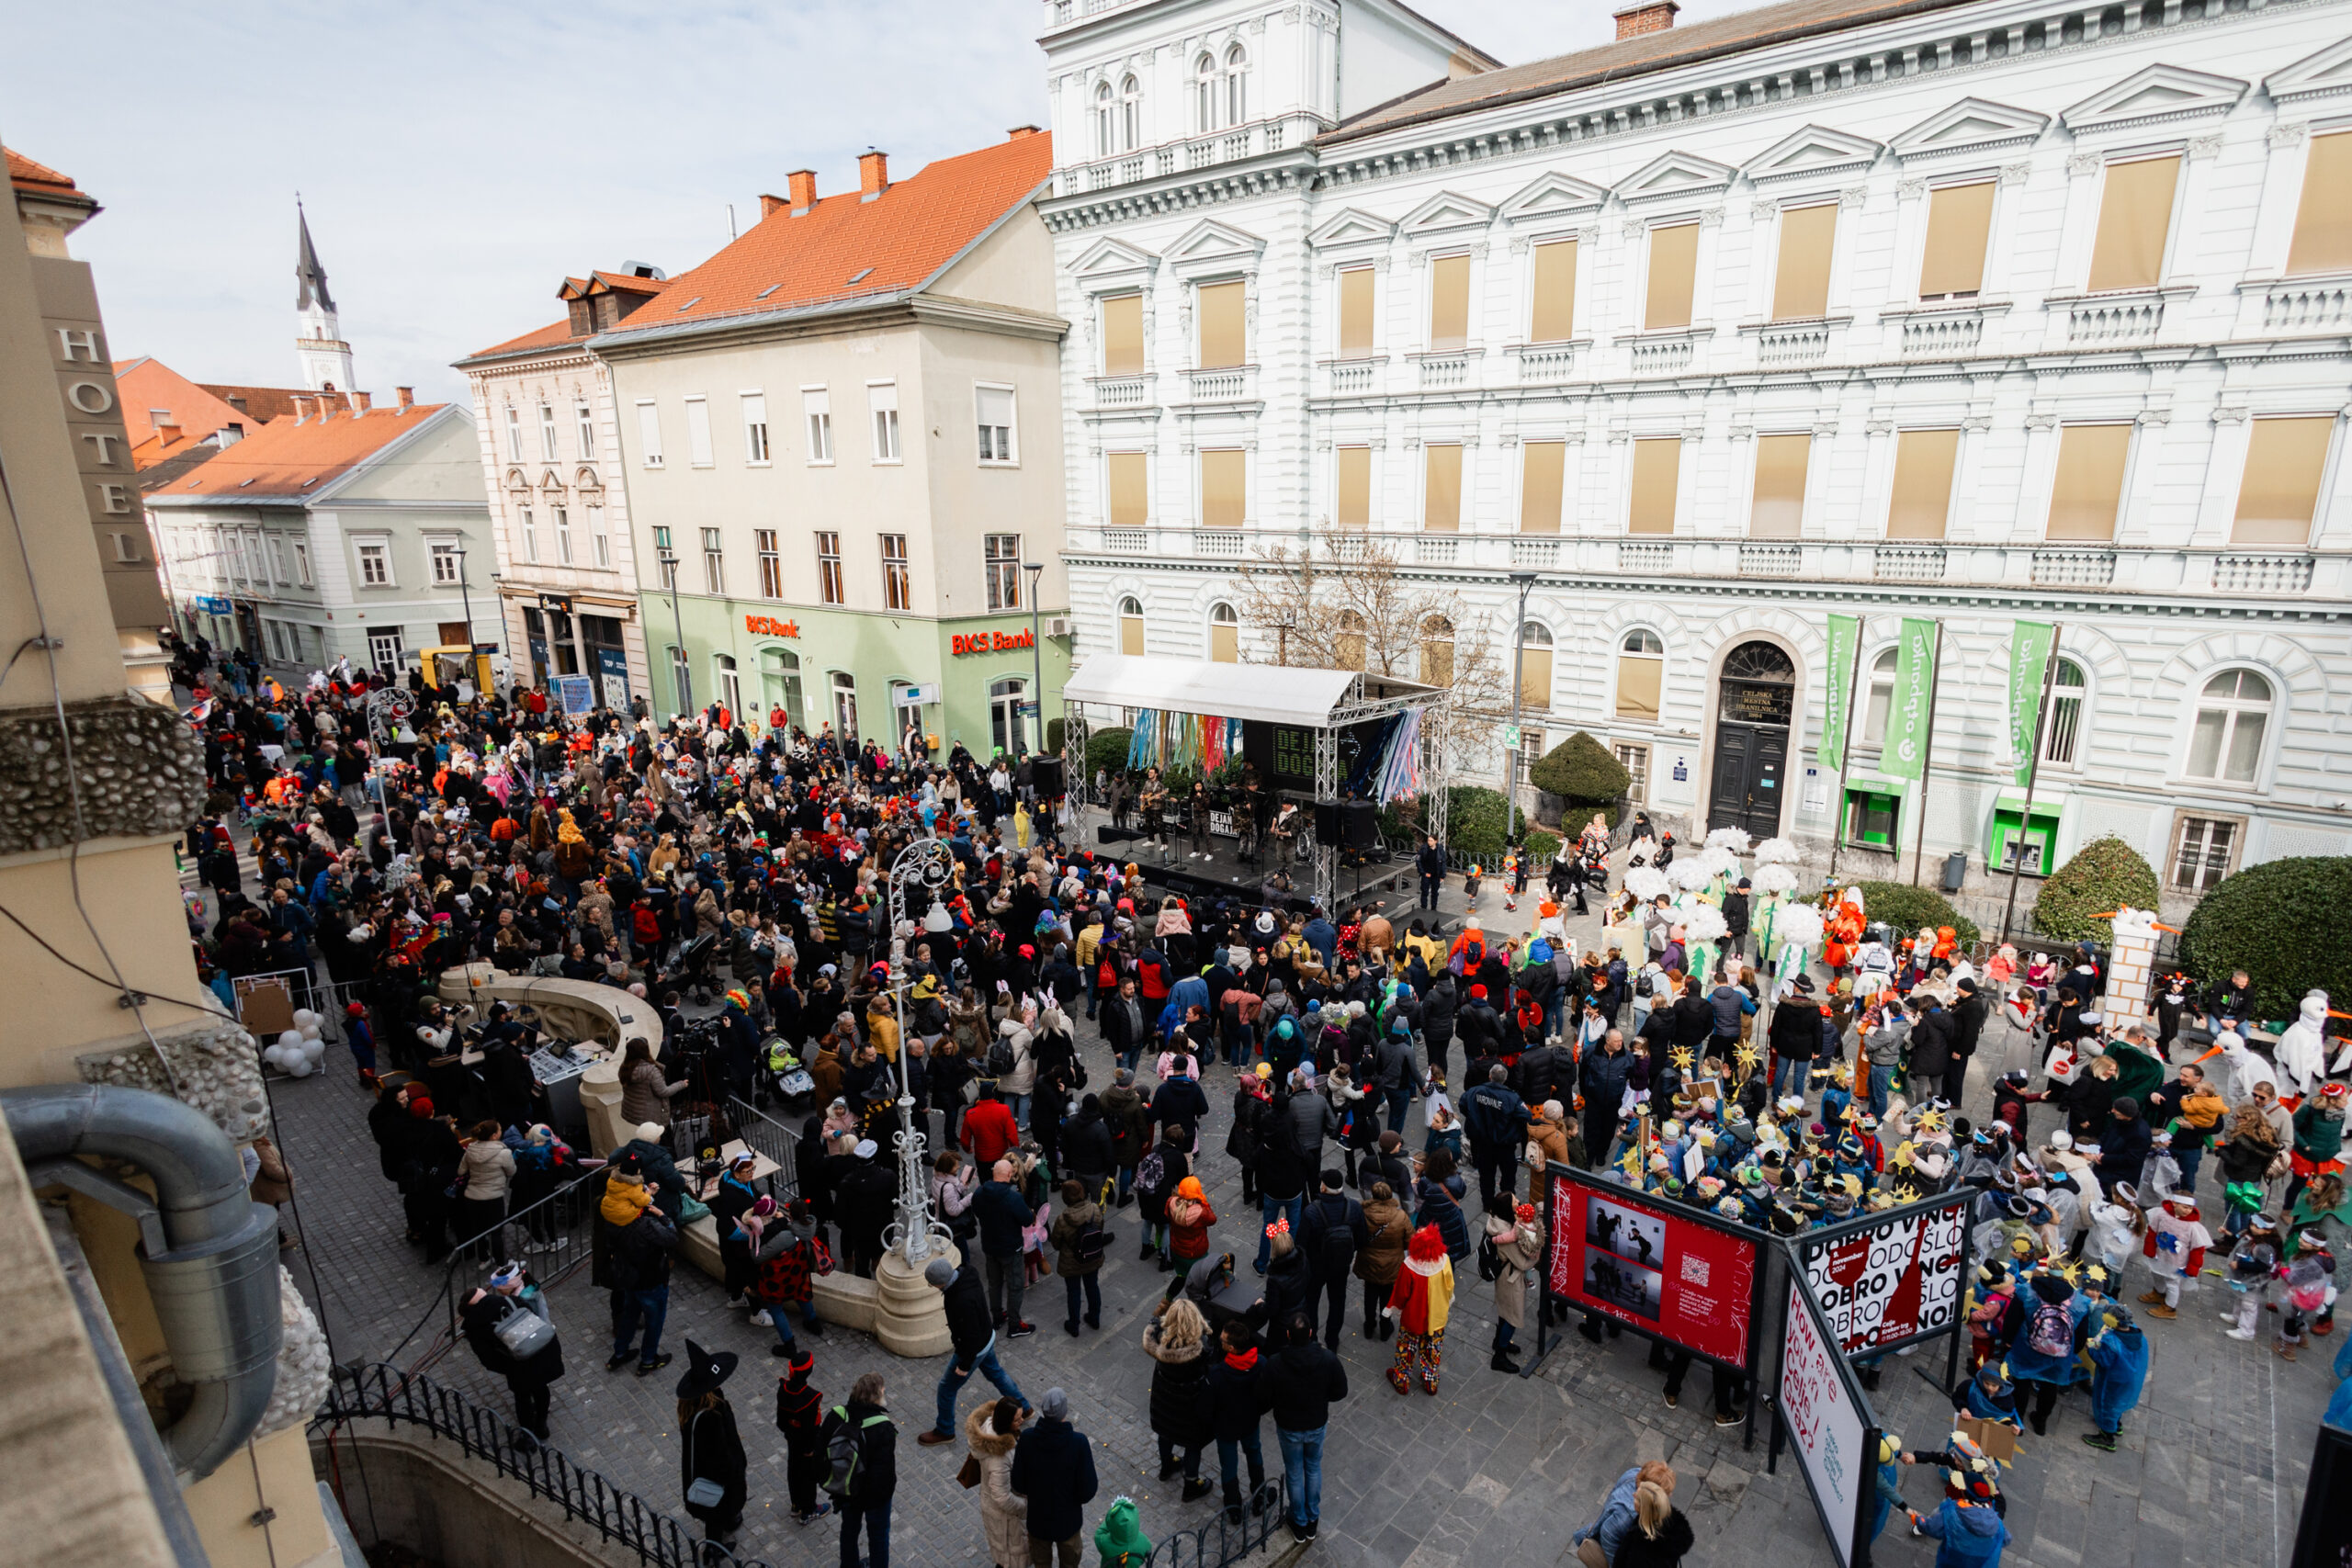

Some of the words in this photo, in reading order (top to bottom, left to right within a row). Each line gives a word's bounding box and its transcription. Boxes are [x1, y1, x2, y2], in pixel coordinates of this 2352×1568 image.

[53, 328, 141, 563] HOTEL
[745, 615, 769, 634] BKS
[769, 617, 797, 638] Bank
[952, 632, 989, 655] BKS
[992, 627, 1035, 650] Bank
[1210, 812, 1233, 825] DEJAN
[1831, 1263, 1847, 1275] 2024
[1832, 1251, 1864, 1267] november
[1787, 1321, 1806, 1372] you
[1792, 1289, 1815, 1352] How
[1816, 1353, 1837, 1403] are
[1786, 1347, 1811, 1419] Celje
[1784, 1374, 1815, 1456] Graz?
